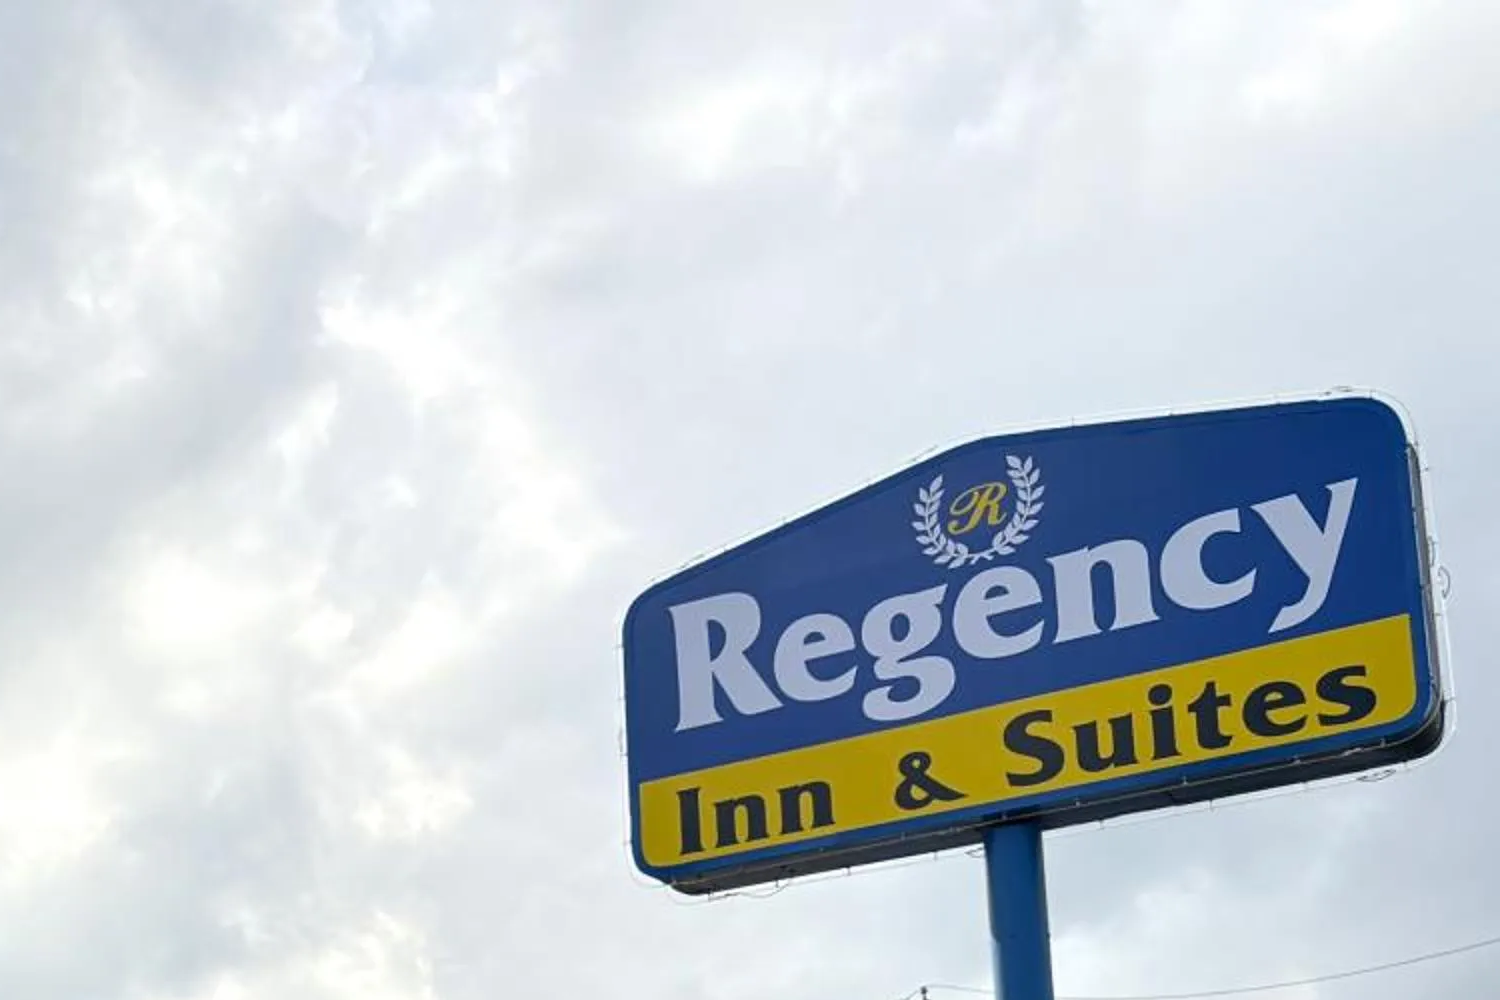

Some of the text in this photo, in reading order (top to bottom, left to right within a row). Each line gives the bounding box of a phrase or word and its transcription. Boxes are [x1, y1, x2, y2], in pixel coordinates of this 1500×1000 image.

[947, 482, 1007, 535] R
[669, 478, 1359, 732] Regency
[676, 664, 1378, 856] Inn & Suites
